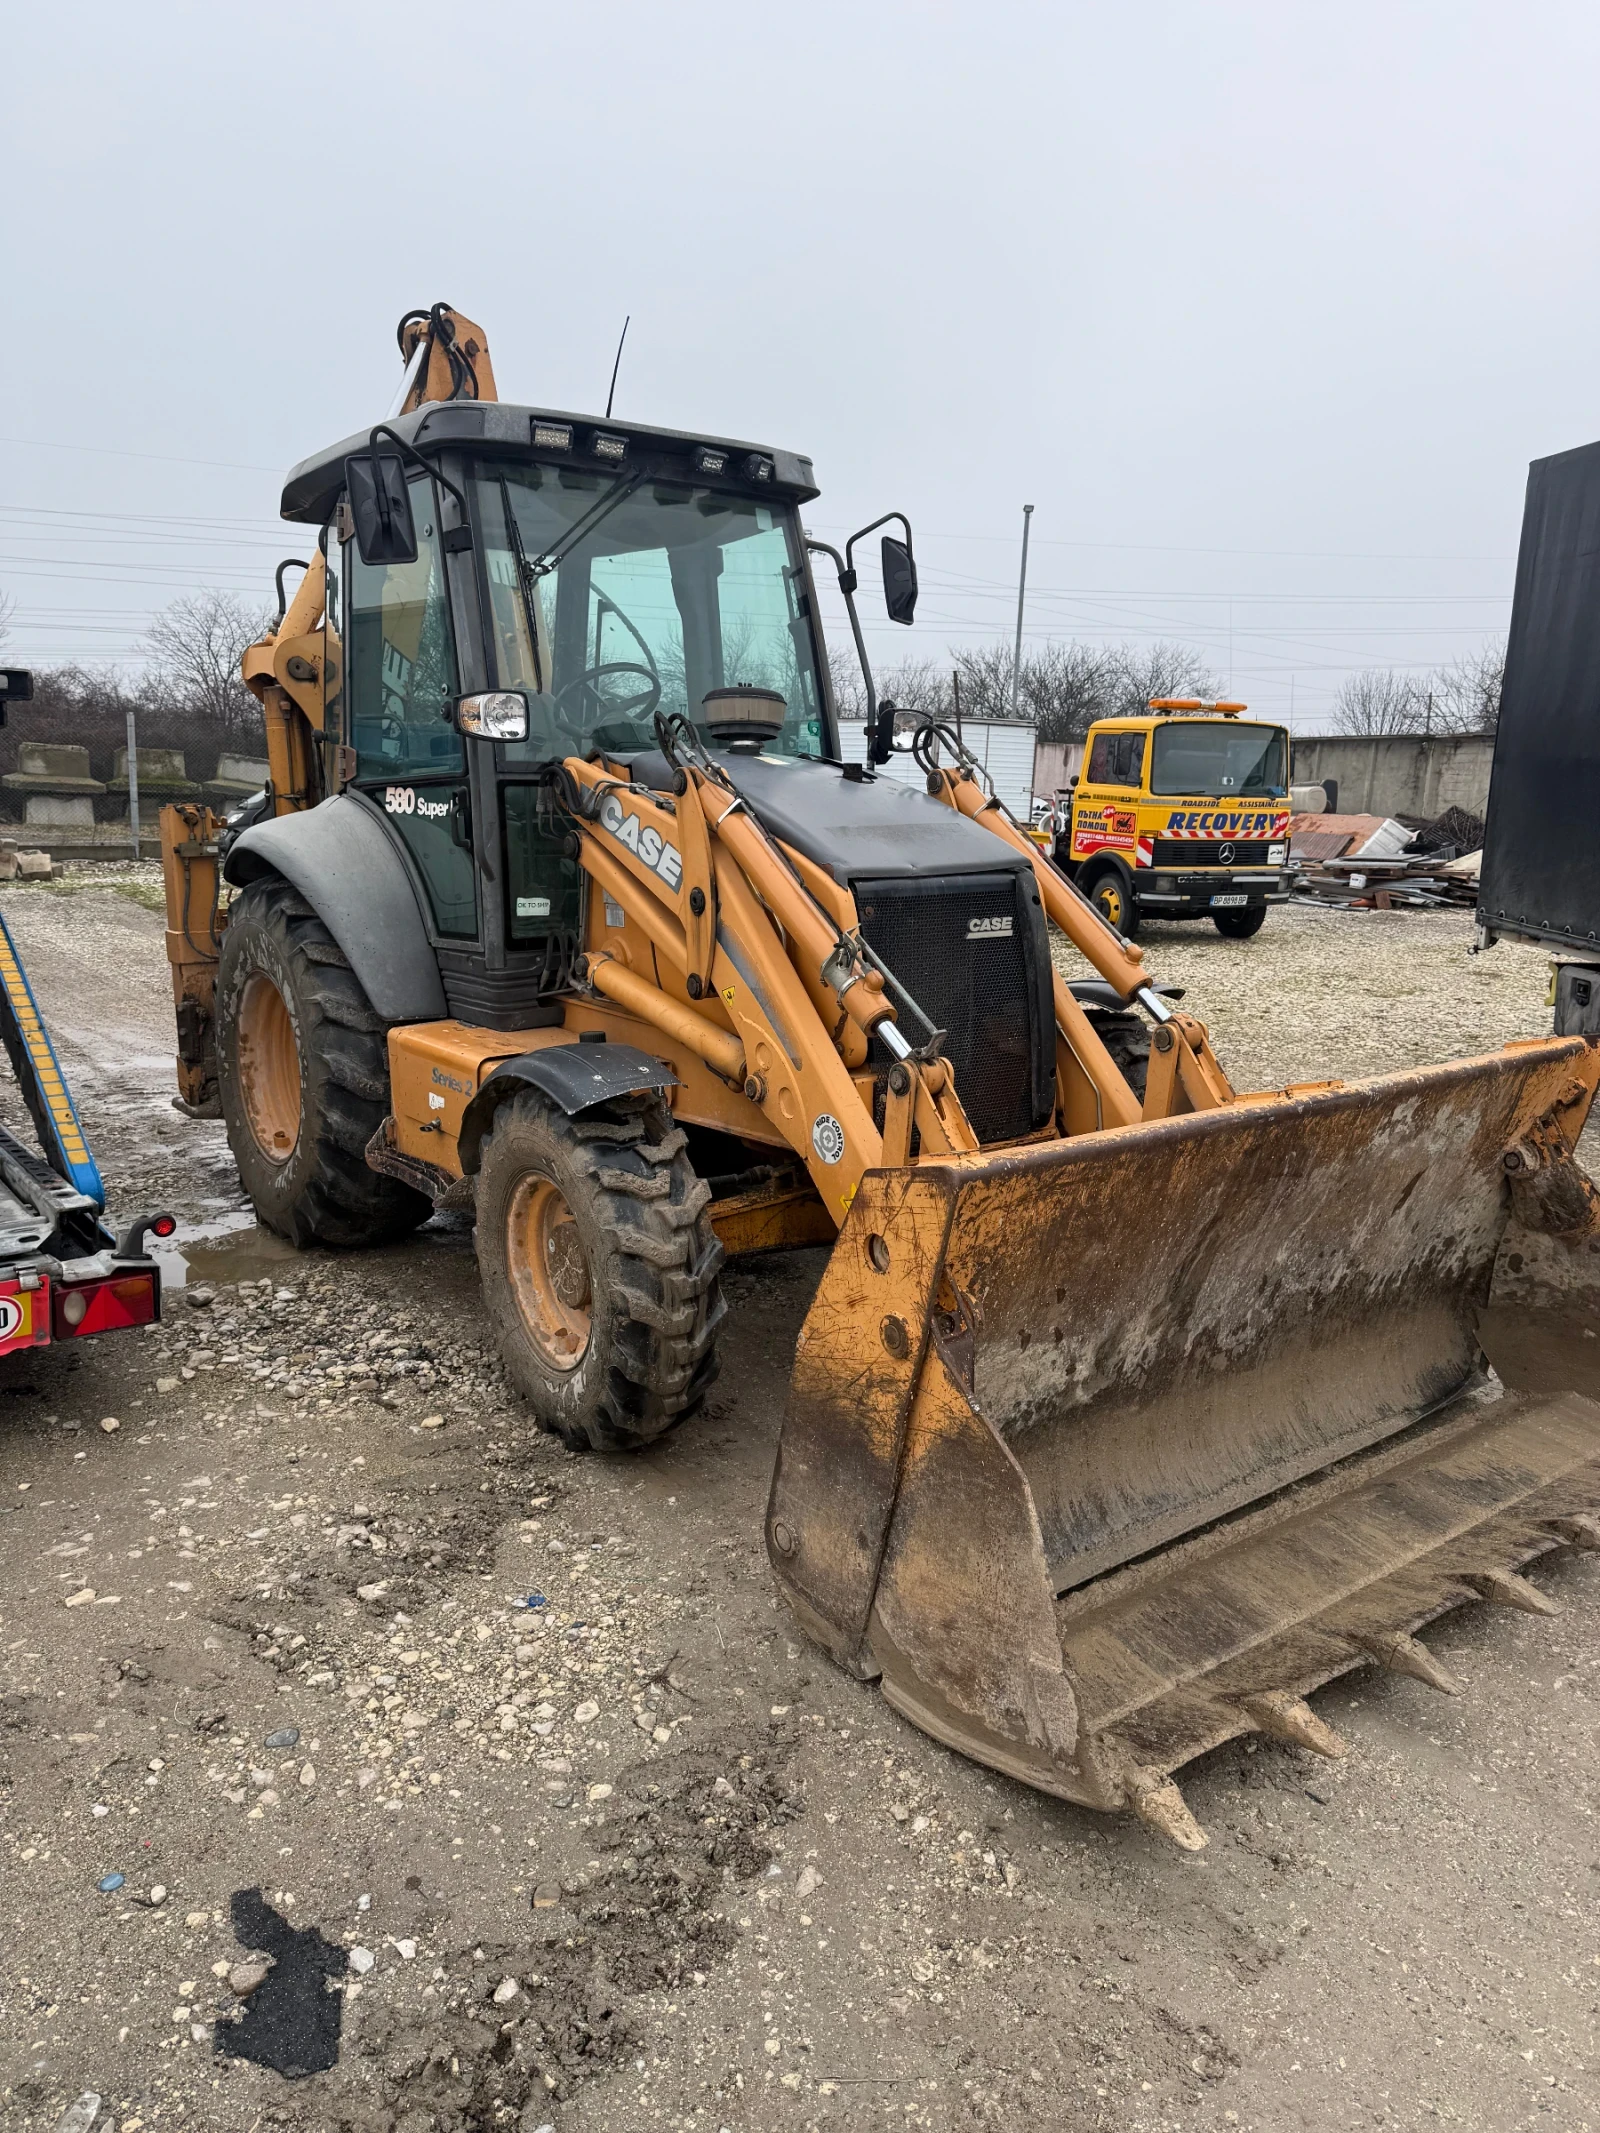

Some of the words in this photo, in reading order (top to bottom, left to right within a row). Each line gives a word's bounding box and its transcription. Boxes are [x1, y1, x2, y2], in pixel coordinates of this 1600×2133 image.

[385, 786, 415, 814] 580
[417, 797, 449, 820] Super
[1078, 810, 1102, 820] ПЪТНА
[1077, 820, 1108, 832] ПОМОЩ
[1167, 812, 1280, 830] RECOVERY
[601, 795, 682, 887] CASE
[969, 917, 1013, 931] CASE
[432, 1067, 462, 1093] Series
[465, 1080, 473, 1097] 2
[815, 1116, 830, 1128] RIDE
[831, 1120, 844, 1161] CONTROL
